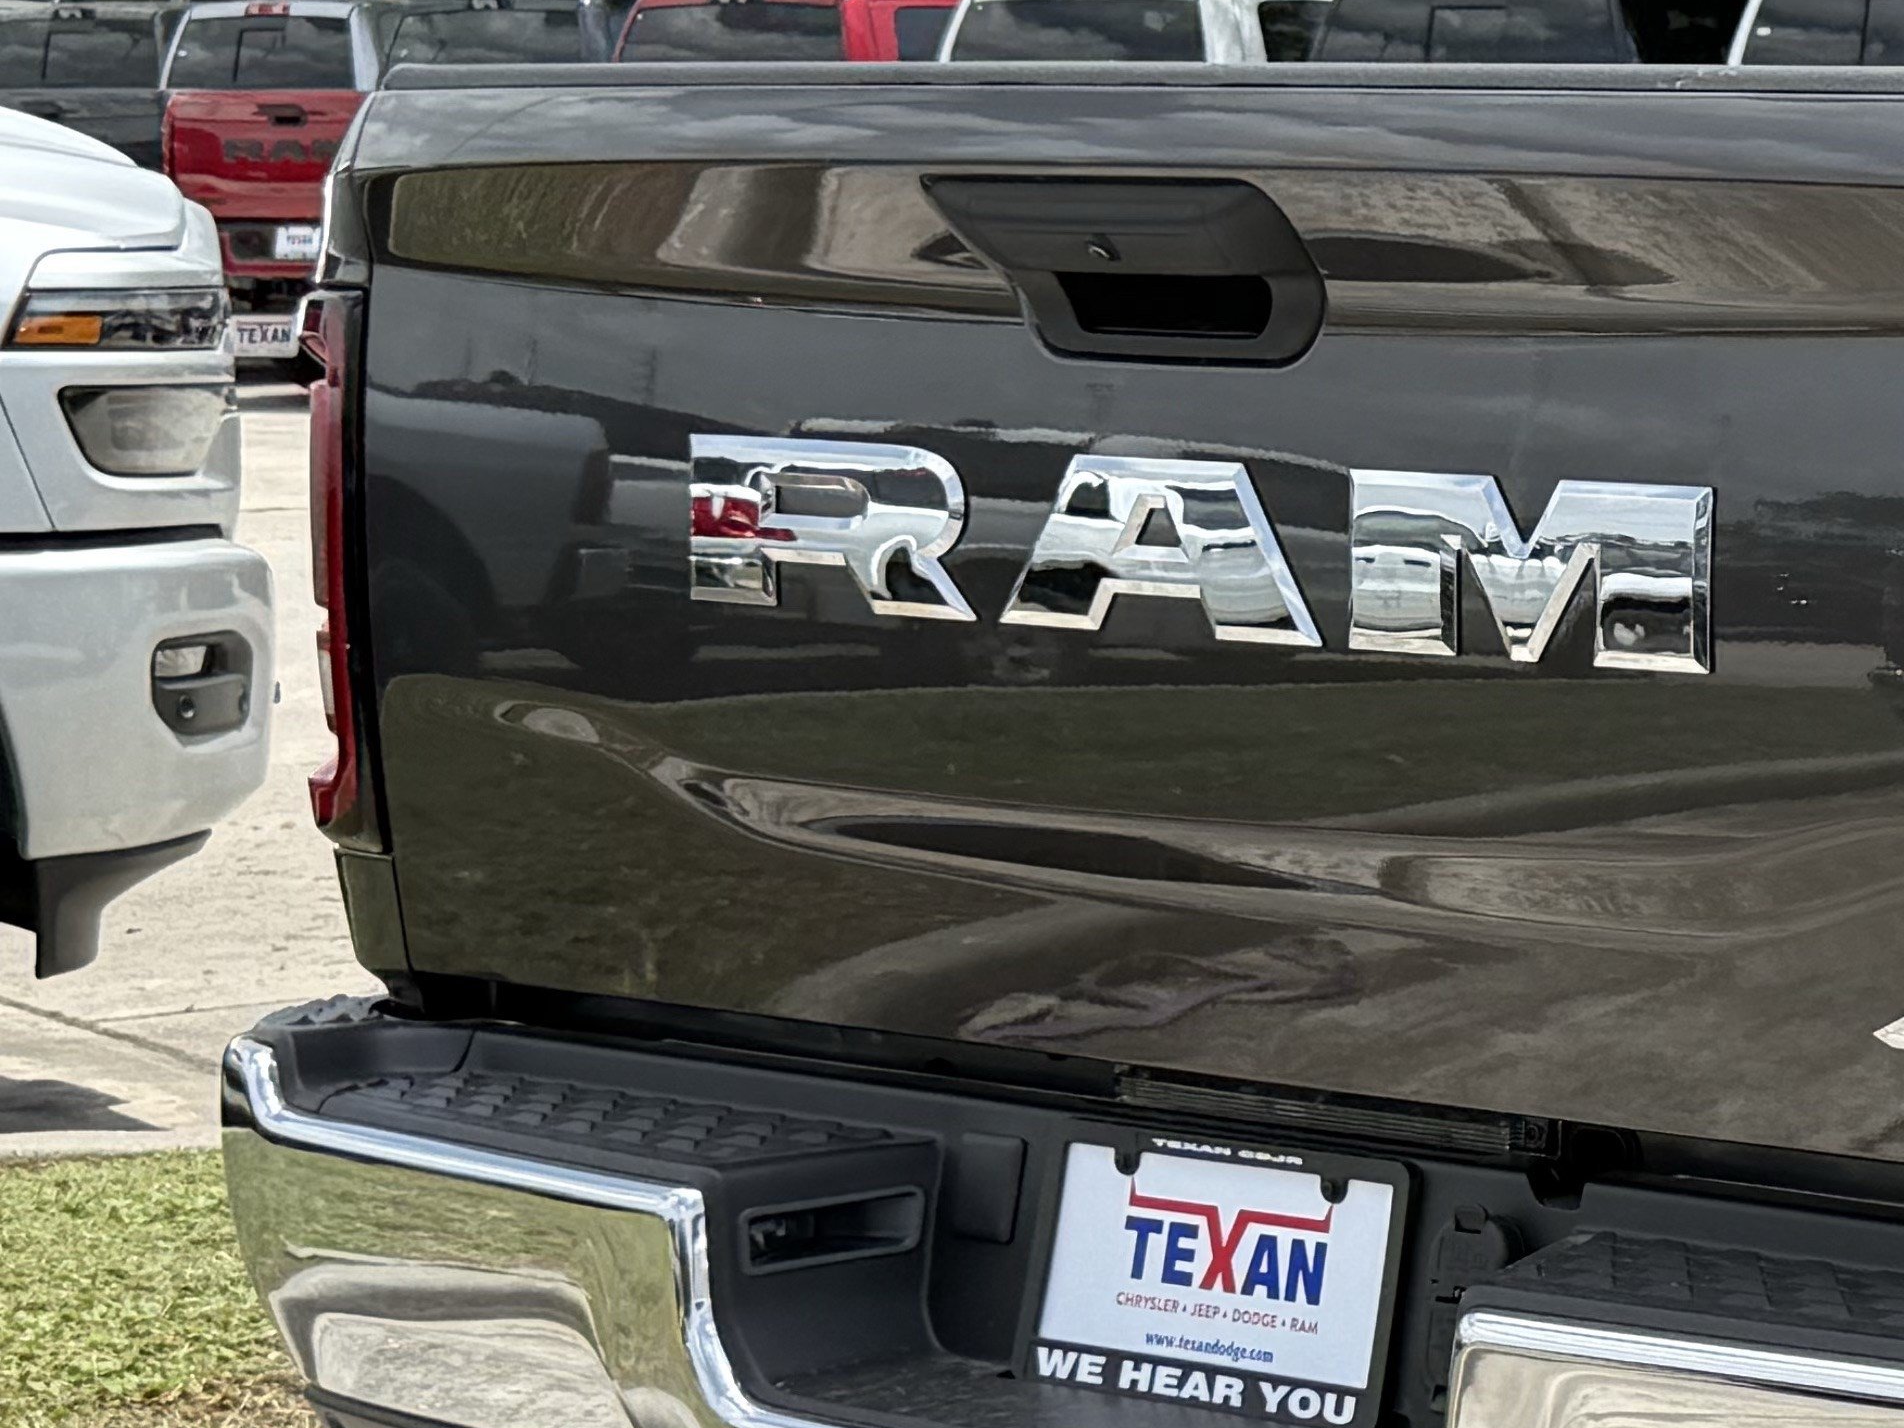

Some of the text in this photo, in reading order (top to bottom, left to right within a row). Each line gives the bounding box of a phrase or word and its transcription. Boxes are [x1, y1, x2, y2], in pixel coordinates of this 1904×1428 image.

[237, 324, 291, 344] TEXAN
[689, 434, 1714, 674] RAM
[1152, 1137, 1231, 1156] TEXAN
[1124, 1194, 1328, 1307] TEXAN
[1116, 1291, 1318, 1335] CHRYSLER JEEP DODGE RAM
[1145, 1332, 1274, 1364] www.texandodge.com
[1036, 1346, 1357, 1427] WE HEAR YOU
